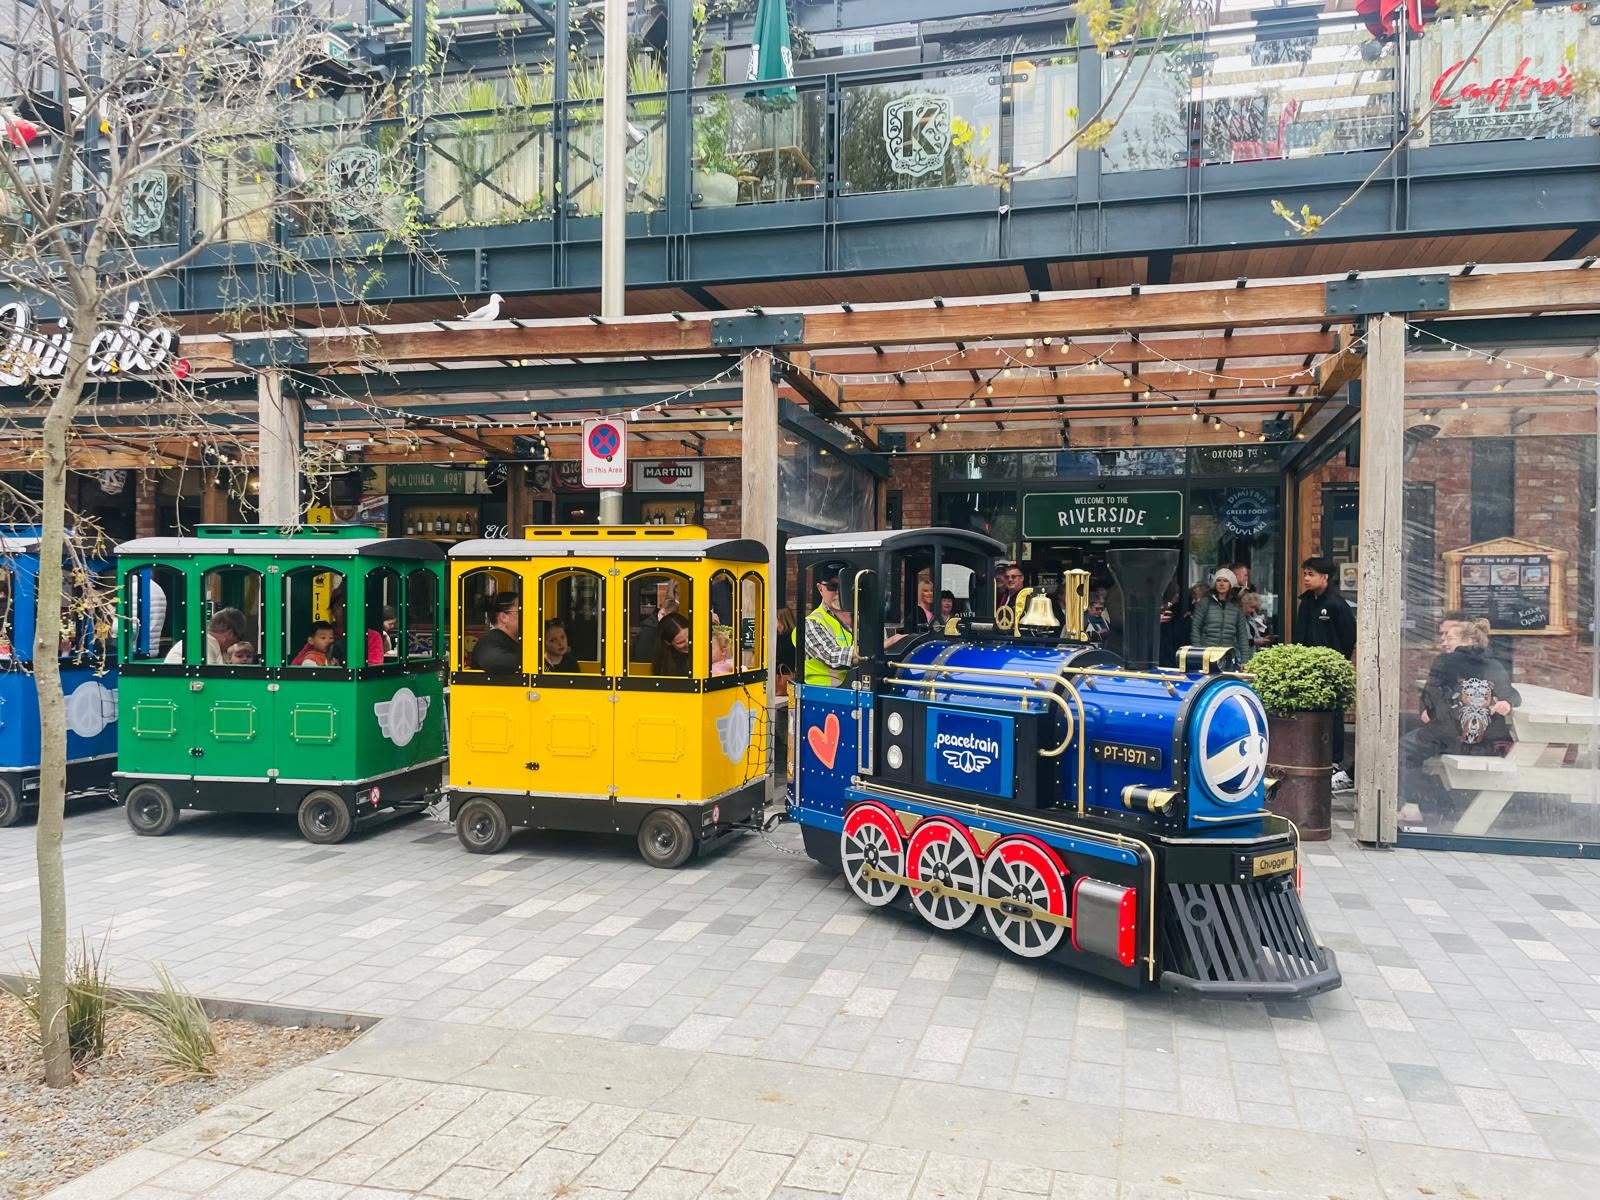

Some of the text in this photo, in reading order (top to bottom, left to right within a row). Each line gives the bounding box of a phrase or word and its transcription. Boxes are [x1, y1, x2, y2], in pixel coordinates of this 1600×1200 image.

[1430, 57, 1574, 111] Castro's
[1454, 115, 1497, 127] TAPAS
[902, 107, 939, 157] K
[1212, 449, 1244, 459] OXFORD
[397, 474, 406, 486] LA
[443, 472, 463, 486] 4987
[646, 468, 691, 476] MARTINI
[1074, 497, 1105, 505] WELCOME
[1116, 496, 1129, 504] THE
[1227, 490, 1267, 504] DIMITRIS
[1057, 506, 1147, 527] RIVERSIDE
[1226, 521, 1267, 536] SOUVLAKI
[936, 733, 998, 759] peacetrain
[1104, 745, 1147, 765] PT-1971
